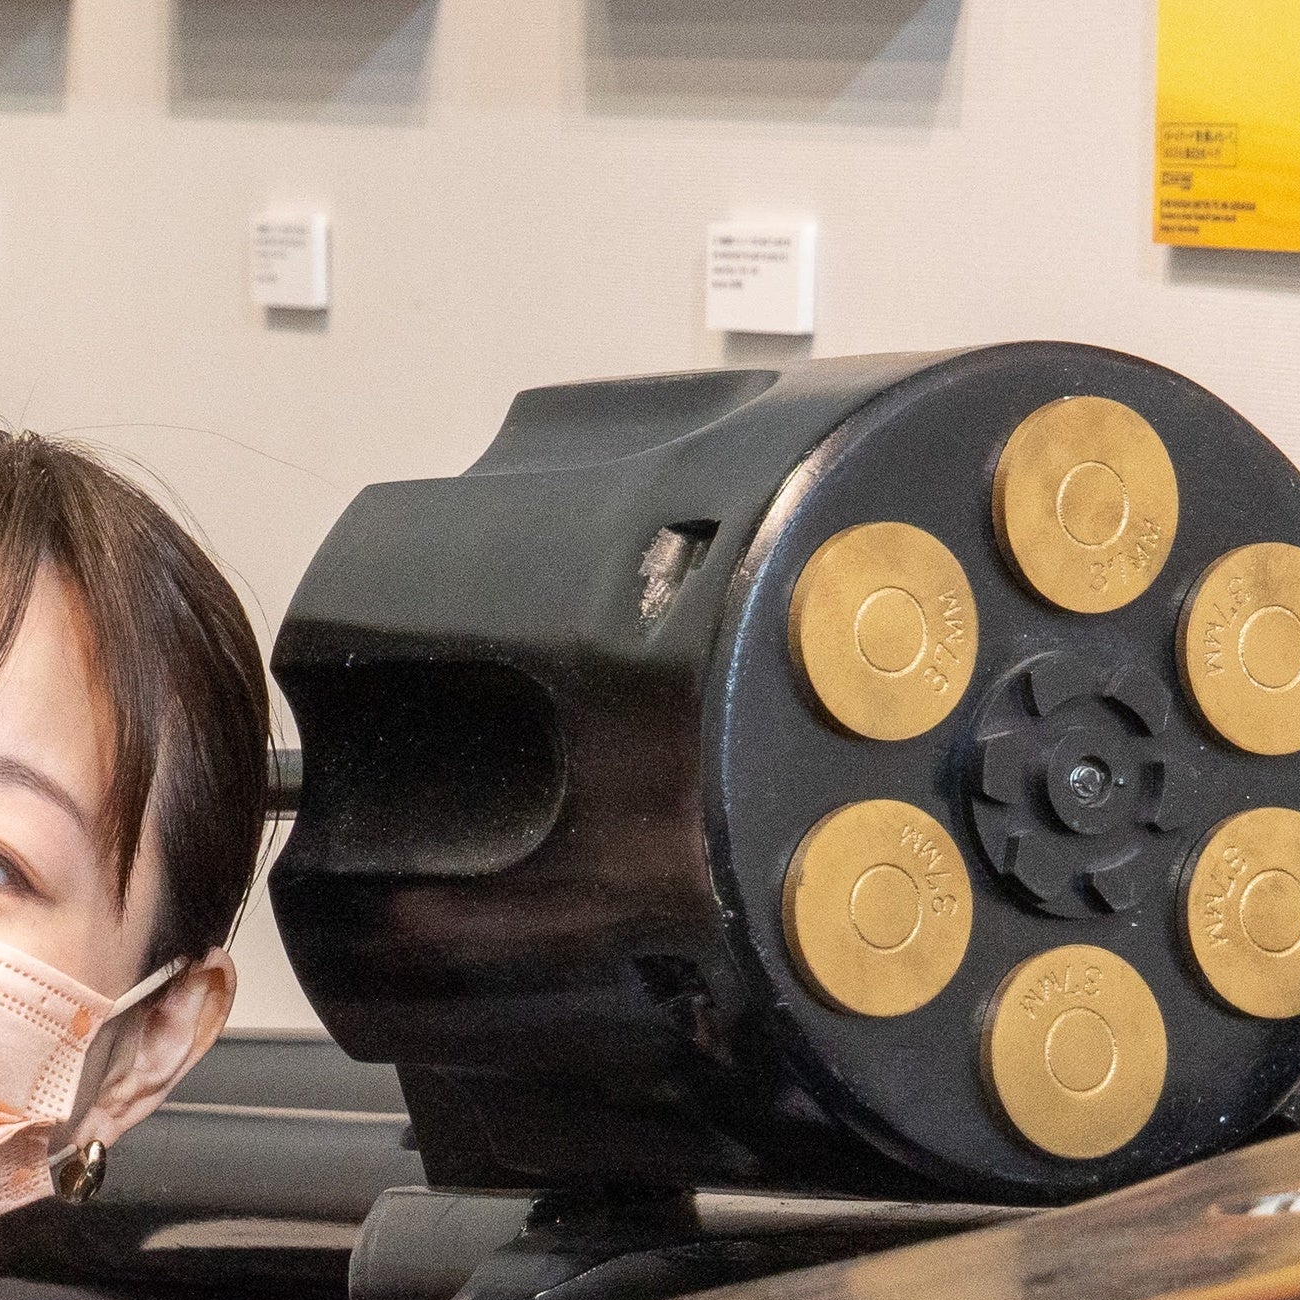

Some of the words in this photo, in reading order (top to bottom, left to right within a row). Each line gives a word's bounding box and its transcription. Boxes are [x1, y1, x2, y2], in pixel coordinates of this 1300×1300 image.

[1089, 516, 1161, 593] 37MM
[922, 587, 965, 694] 37MM
[1202, 576, 1253, 677] 37MM
[898, 823, 960, 918] 37MM
[1202, 845, 1249, 949] 37MM
[1019, 965, 1103, 1021] 37MM
